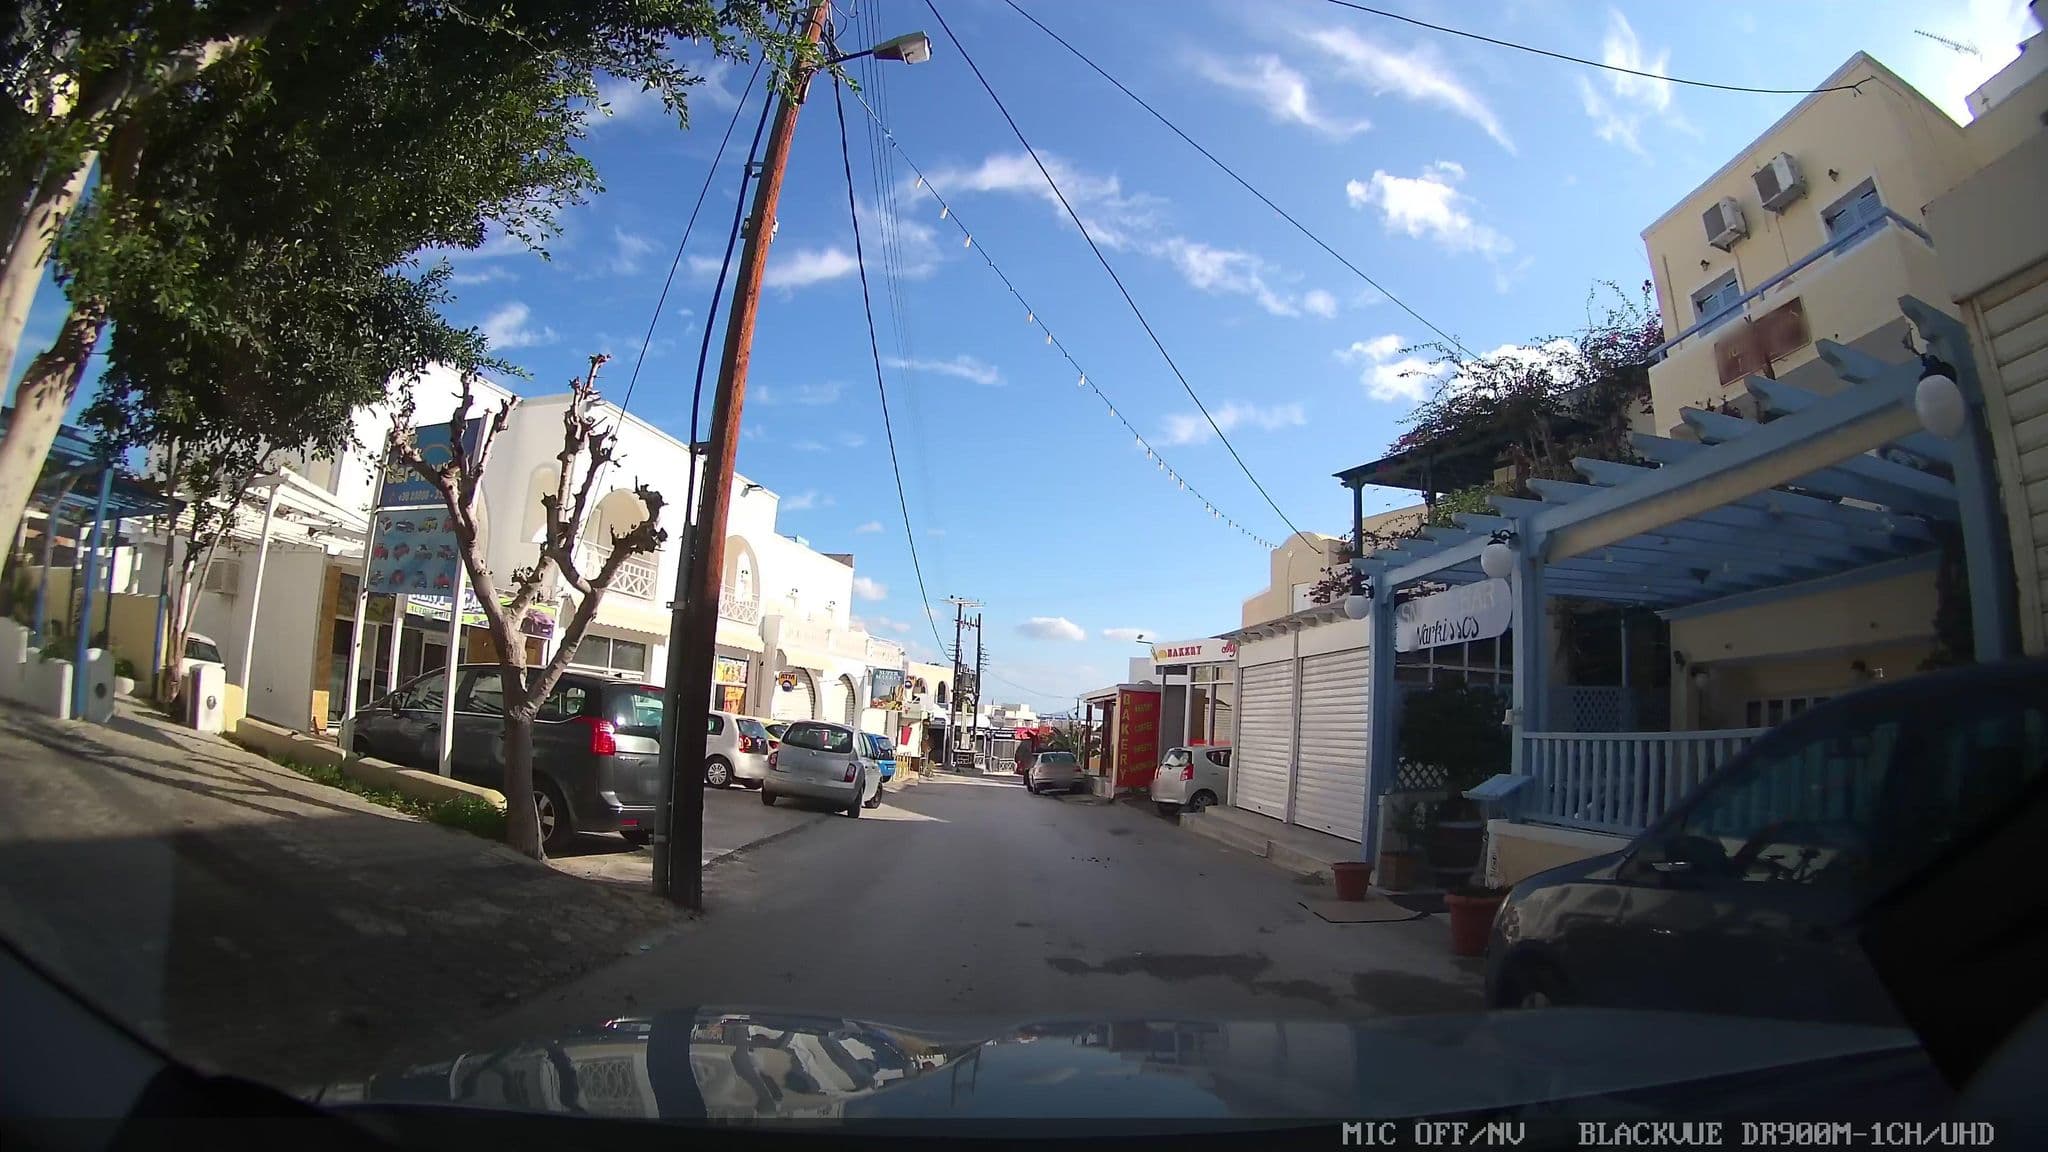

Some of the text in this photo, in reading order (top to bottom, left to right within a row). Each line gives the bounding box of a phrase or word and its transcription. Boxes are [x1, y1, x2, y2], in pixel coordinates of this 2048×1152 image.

[1167, 645, 1202, 658] BAKERY
[780, 673, 796, 681] ATM
[1119, 693, 1131, 781] BAKERY
